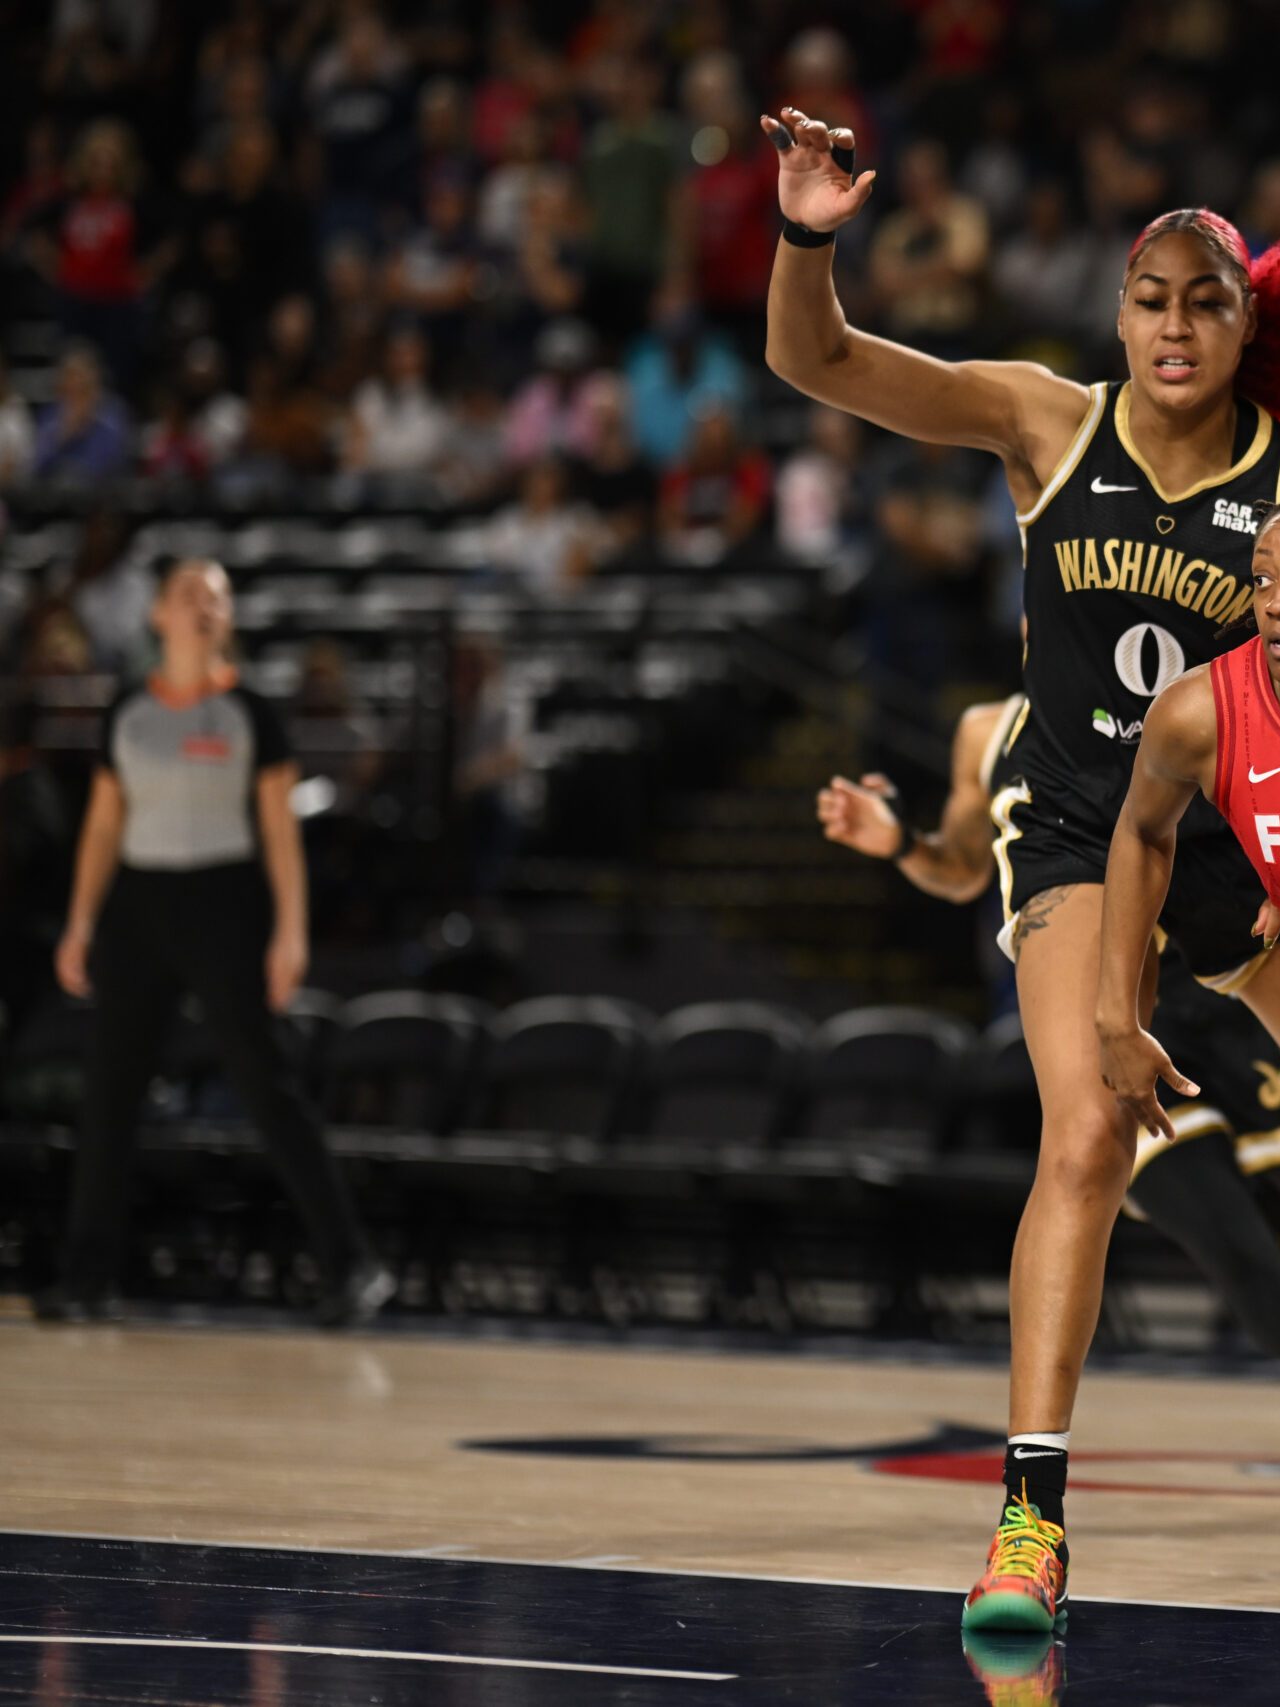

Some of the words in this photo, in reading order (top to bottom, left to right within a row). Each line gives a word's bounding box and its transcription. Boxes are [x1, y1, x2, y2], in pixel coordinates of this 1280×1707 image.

[1214, 498, 1253, 520] CAR
[1212, 511, 1259, 535] max
[1054, 538, 1254, 624] WASHINGTON
[1114, 622, 1185, 697] 0
[1116, 718, 1143, 739] VA
